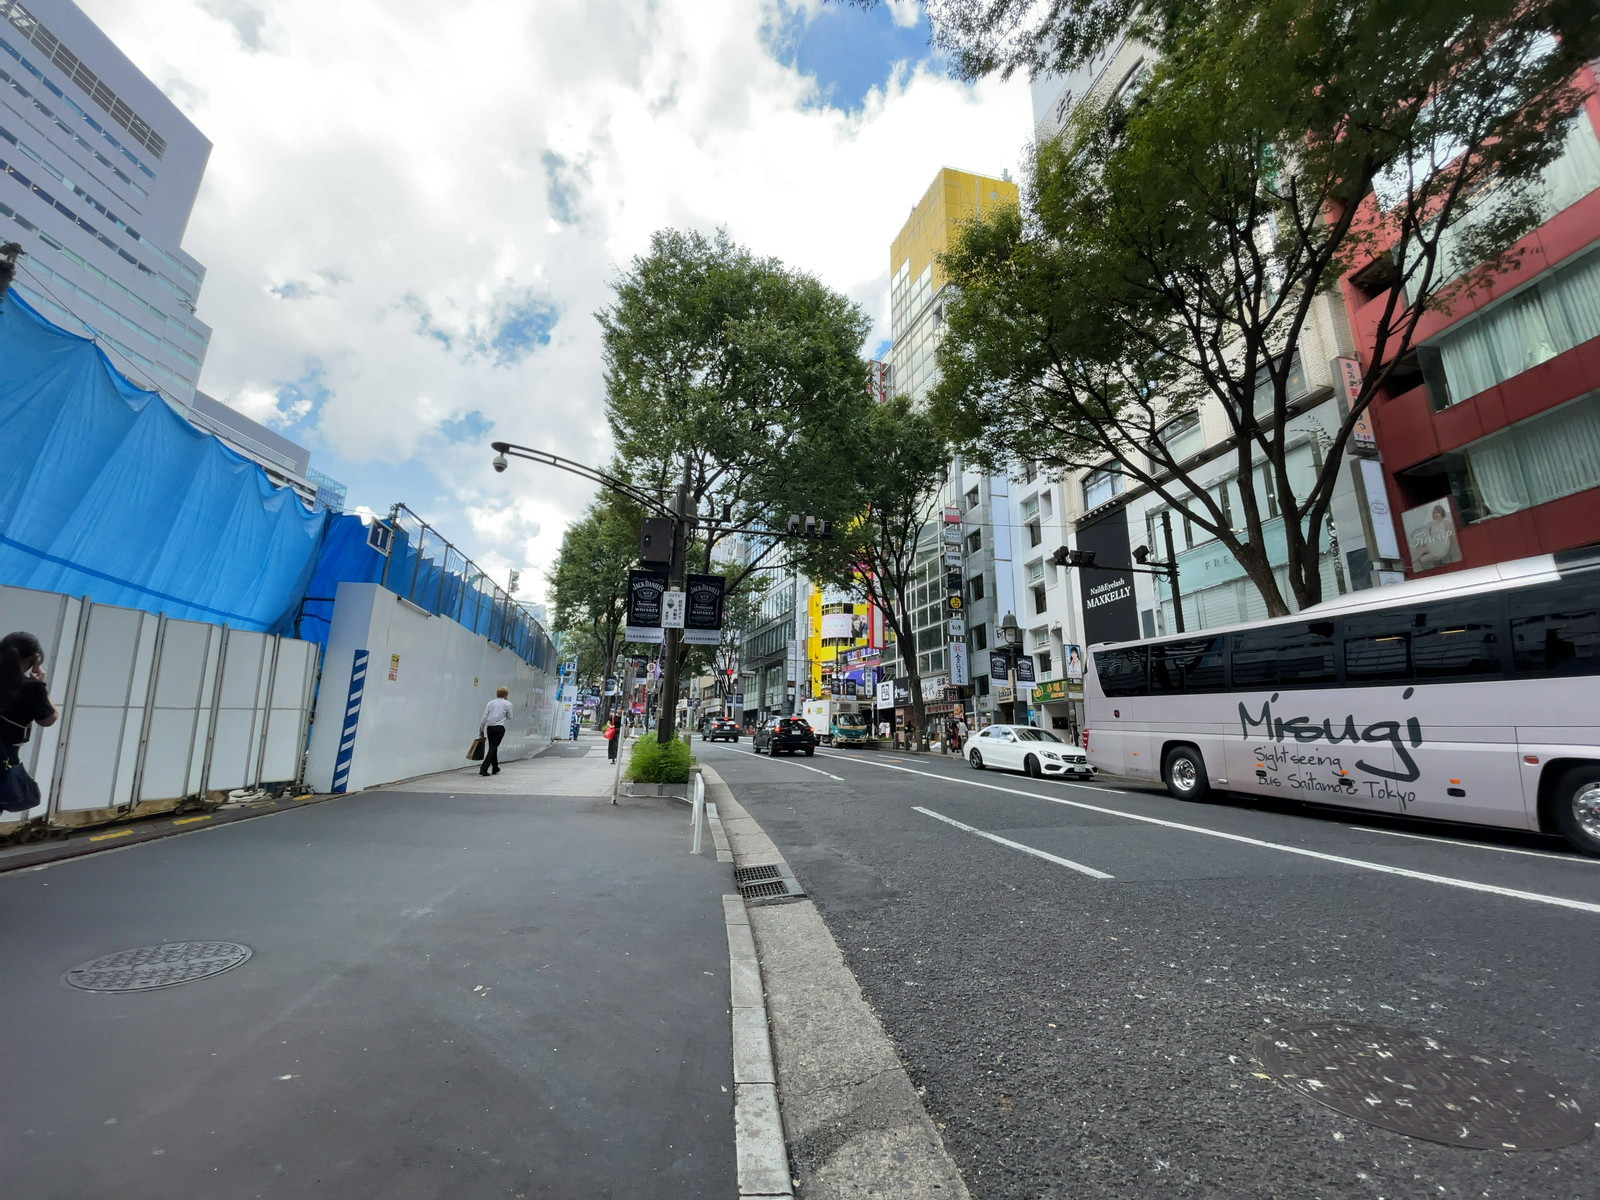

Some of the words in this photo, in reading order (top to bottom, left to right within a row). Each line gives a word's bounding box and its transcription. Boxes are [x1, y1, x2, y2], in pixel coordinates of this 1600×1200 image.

[377, 528, 383, 545] 1
[632, 580, 646, 591] JACK
[1090, 577, 1125, 595] Nail&Eyelash
[1086, 585, 1131, 609] MAXKELLY
[1238, 687, 1422, 782] Misugi
[1257, 774, 1282, 787] Bus
[1287, 772, 1343, 794] Saitama
[1362, 780, 1416, 810] Tokyo
